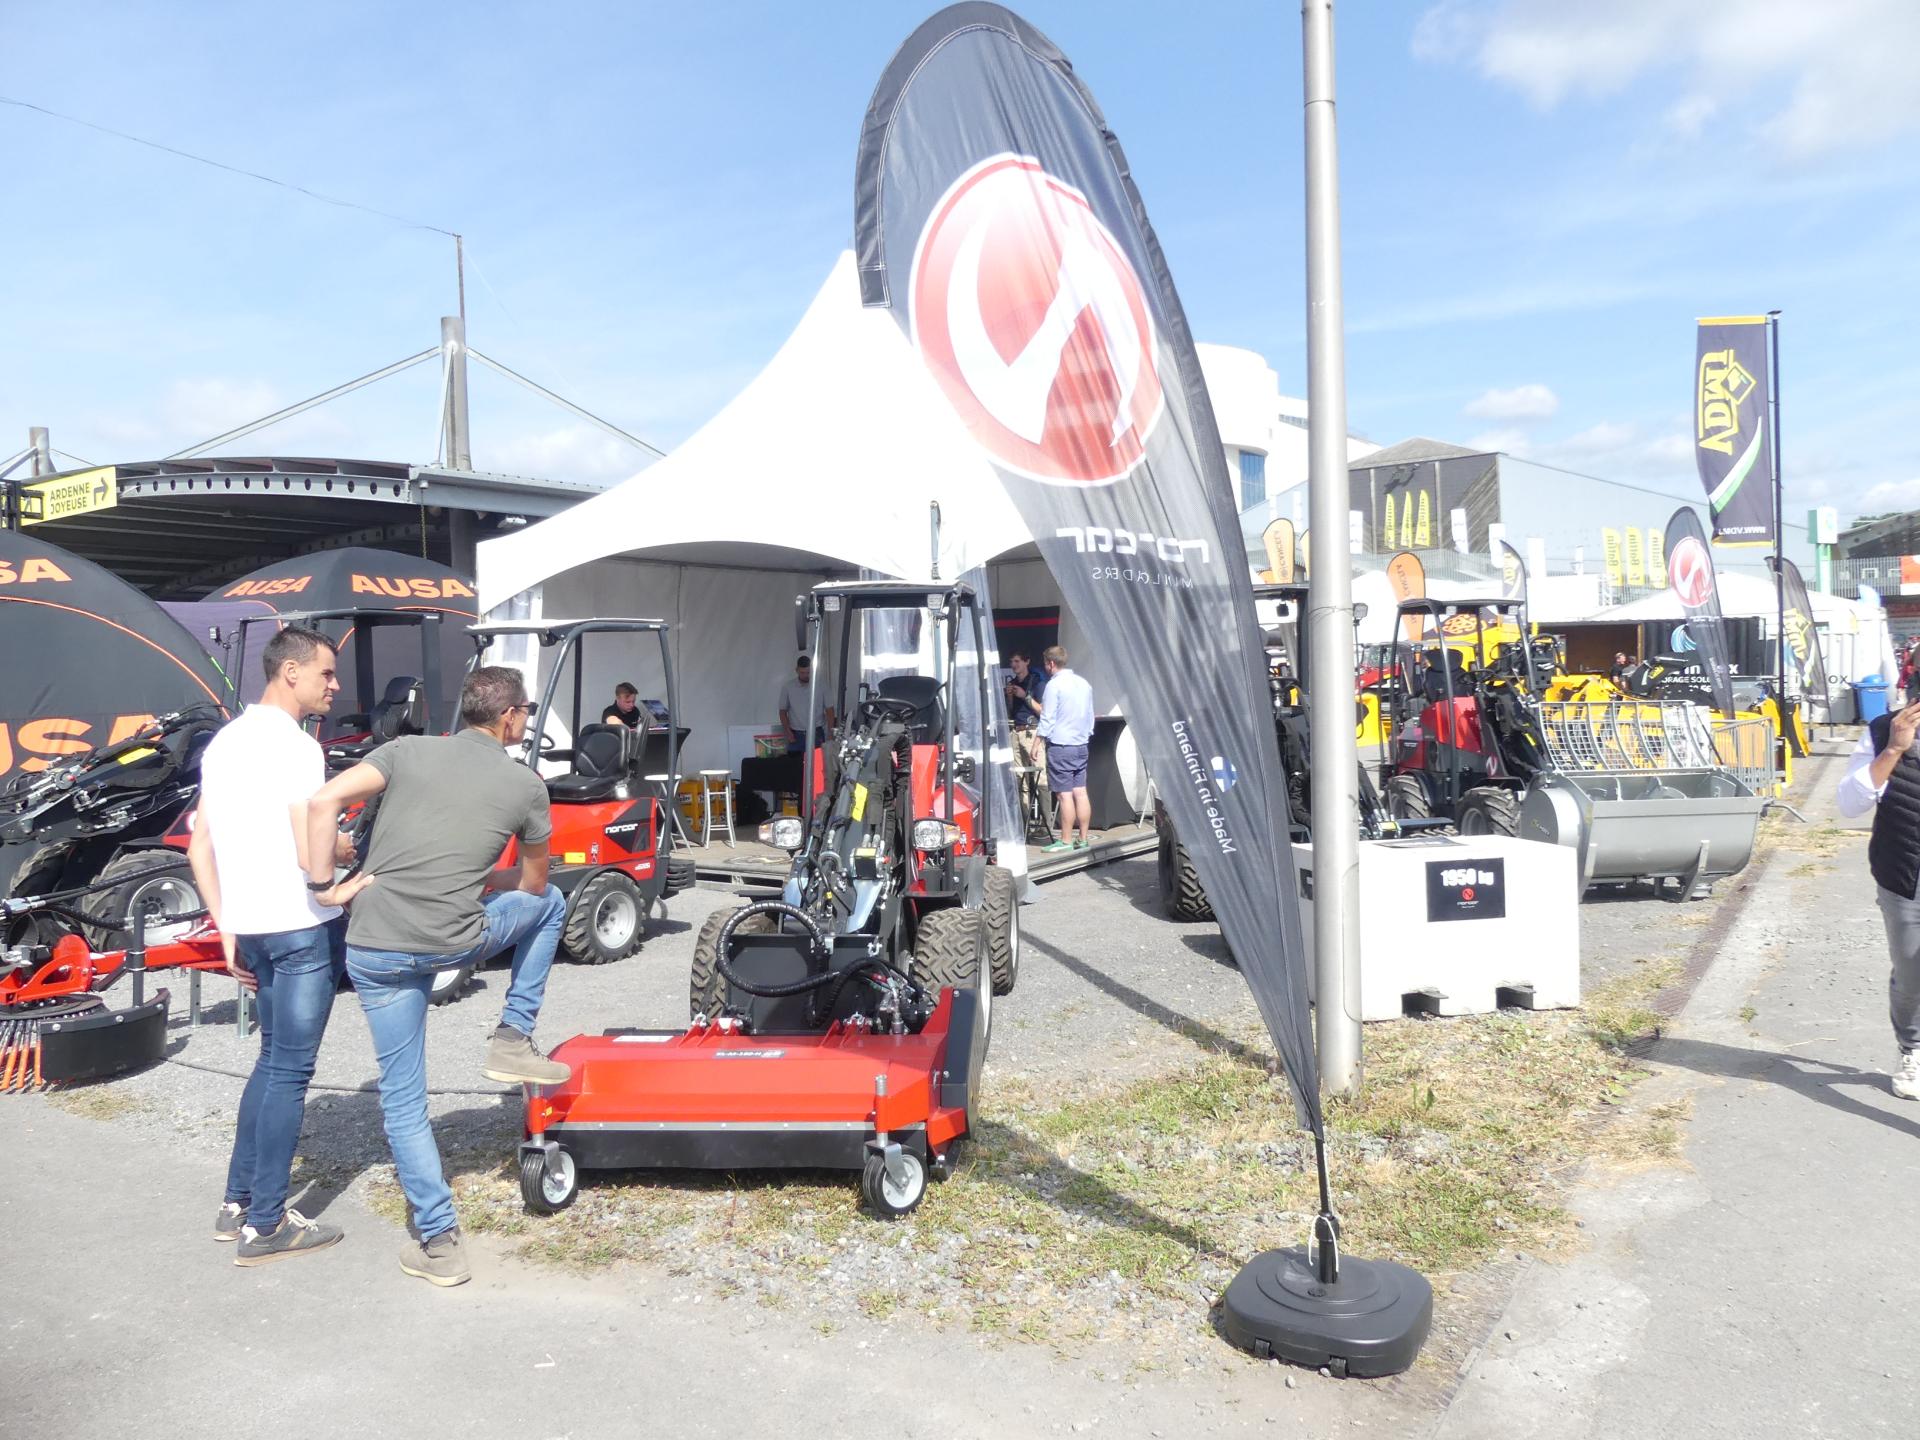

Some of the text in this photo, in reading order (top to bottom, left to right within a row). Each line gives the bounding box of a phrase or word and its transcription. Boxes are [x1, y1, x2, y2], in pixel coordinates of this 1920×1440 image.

[50, 482, 91, 501] ARDENNE
[50, 496, 88, 515] JOYEUSE
[223, 575, 313, 598] AUSA
[351, 574, 476, 598] AUSA
[605, 823, 639, 835] norcar
